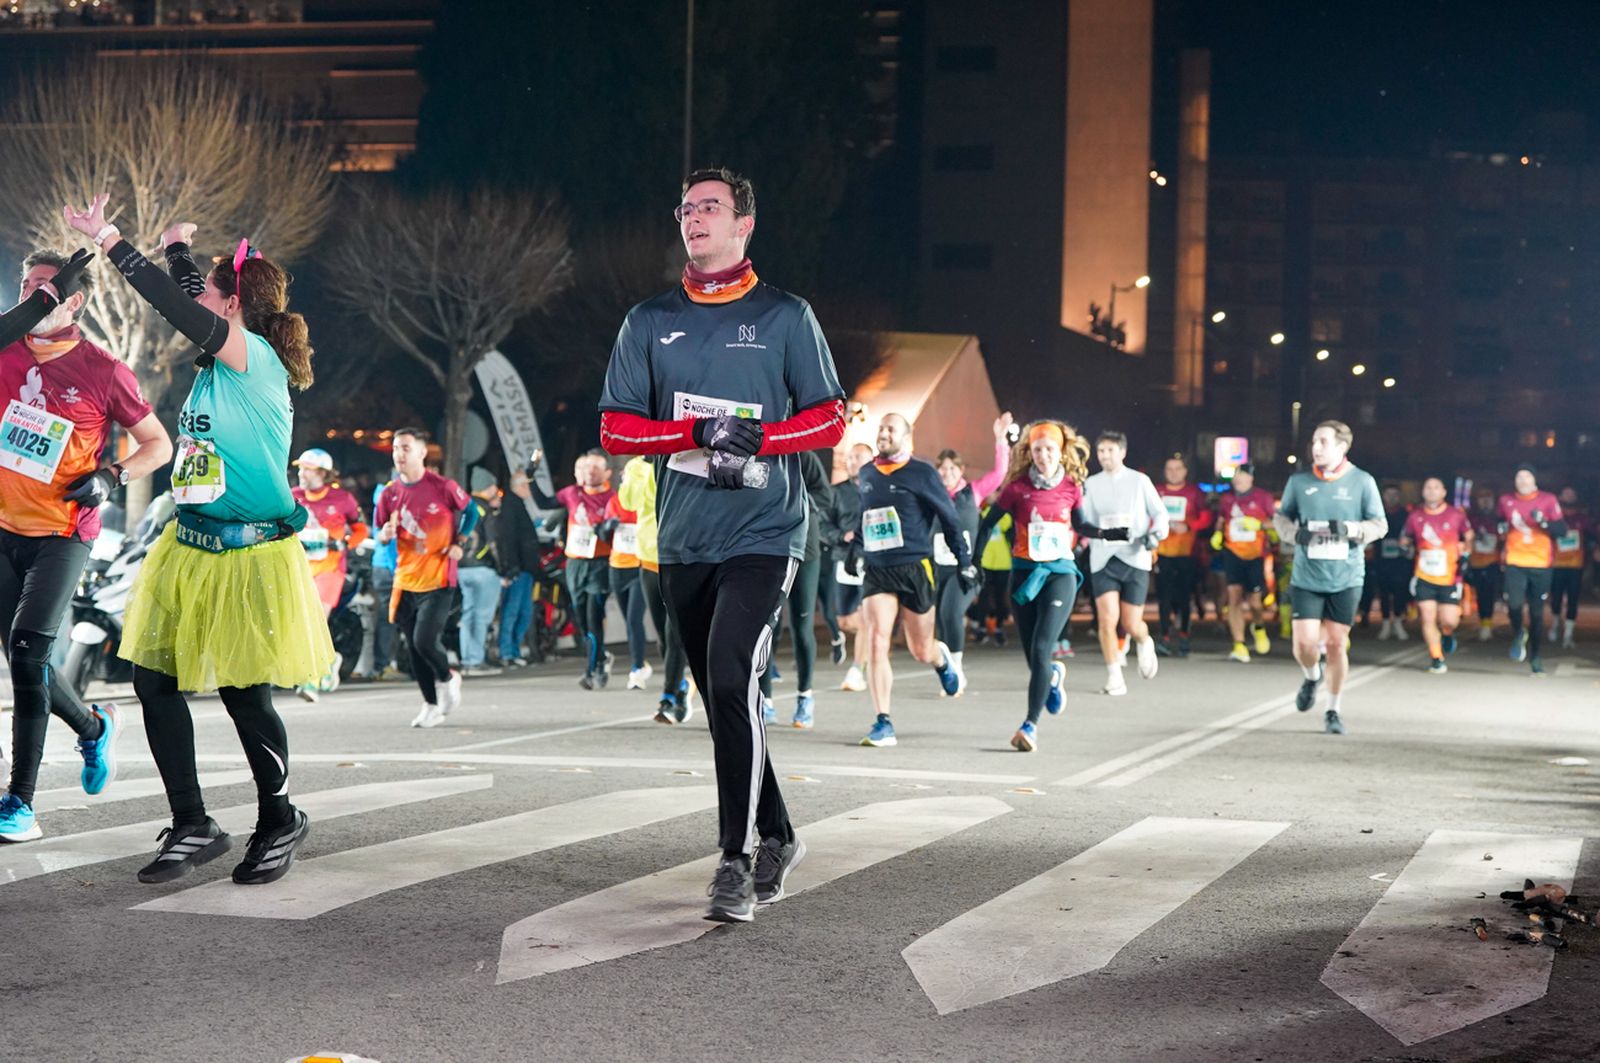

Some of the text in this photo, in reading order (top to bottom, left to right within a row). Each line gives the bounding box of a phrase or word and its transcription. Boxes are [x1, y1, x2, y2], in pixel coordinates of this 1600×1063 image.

[19, 410, 37, 422] NOCHE
[692, 403, 717, 416] NOCHE
[717, 408, 728, 417] DE
[7, 426, 51, 457] 4025
[176, 521, 225, 551] RTICA
